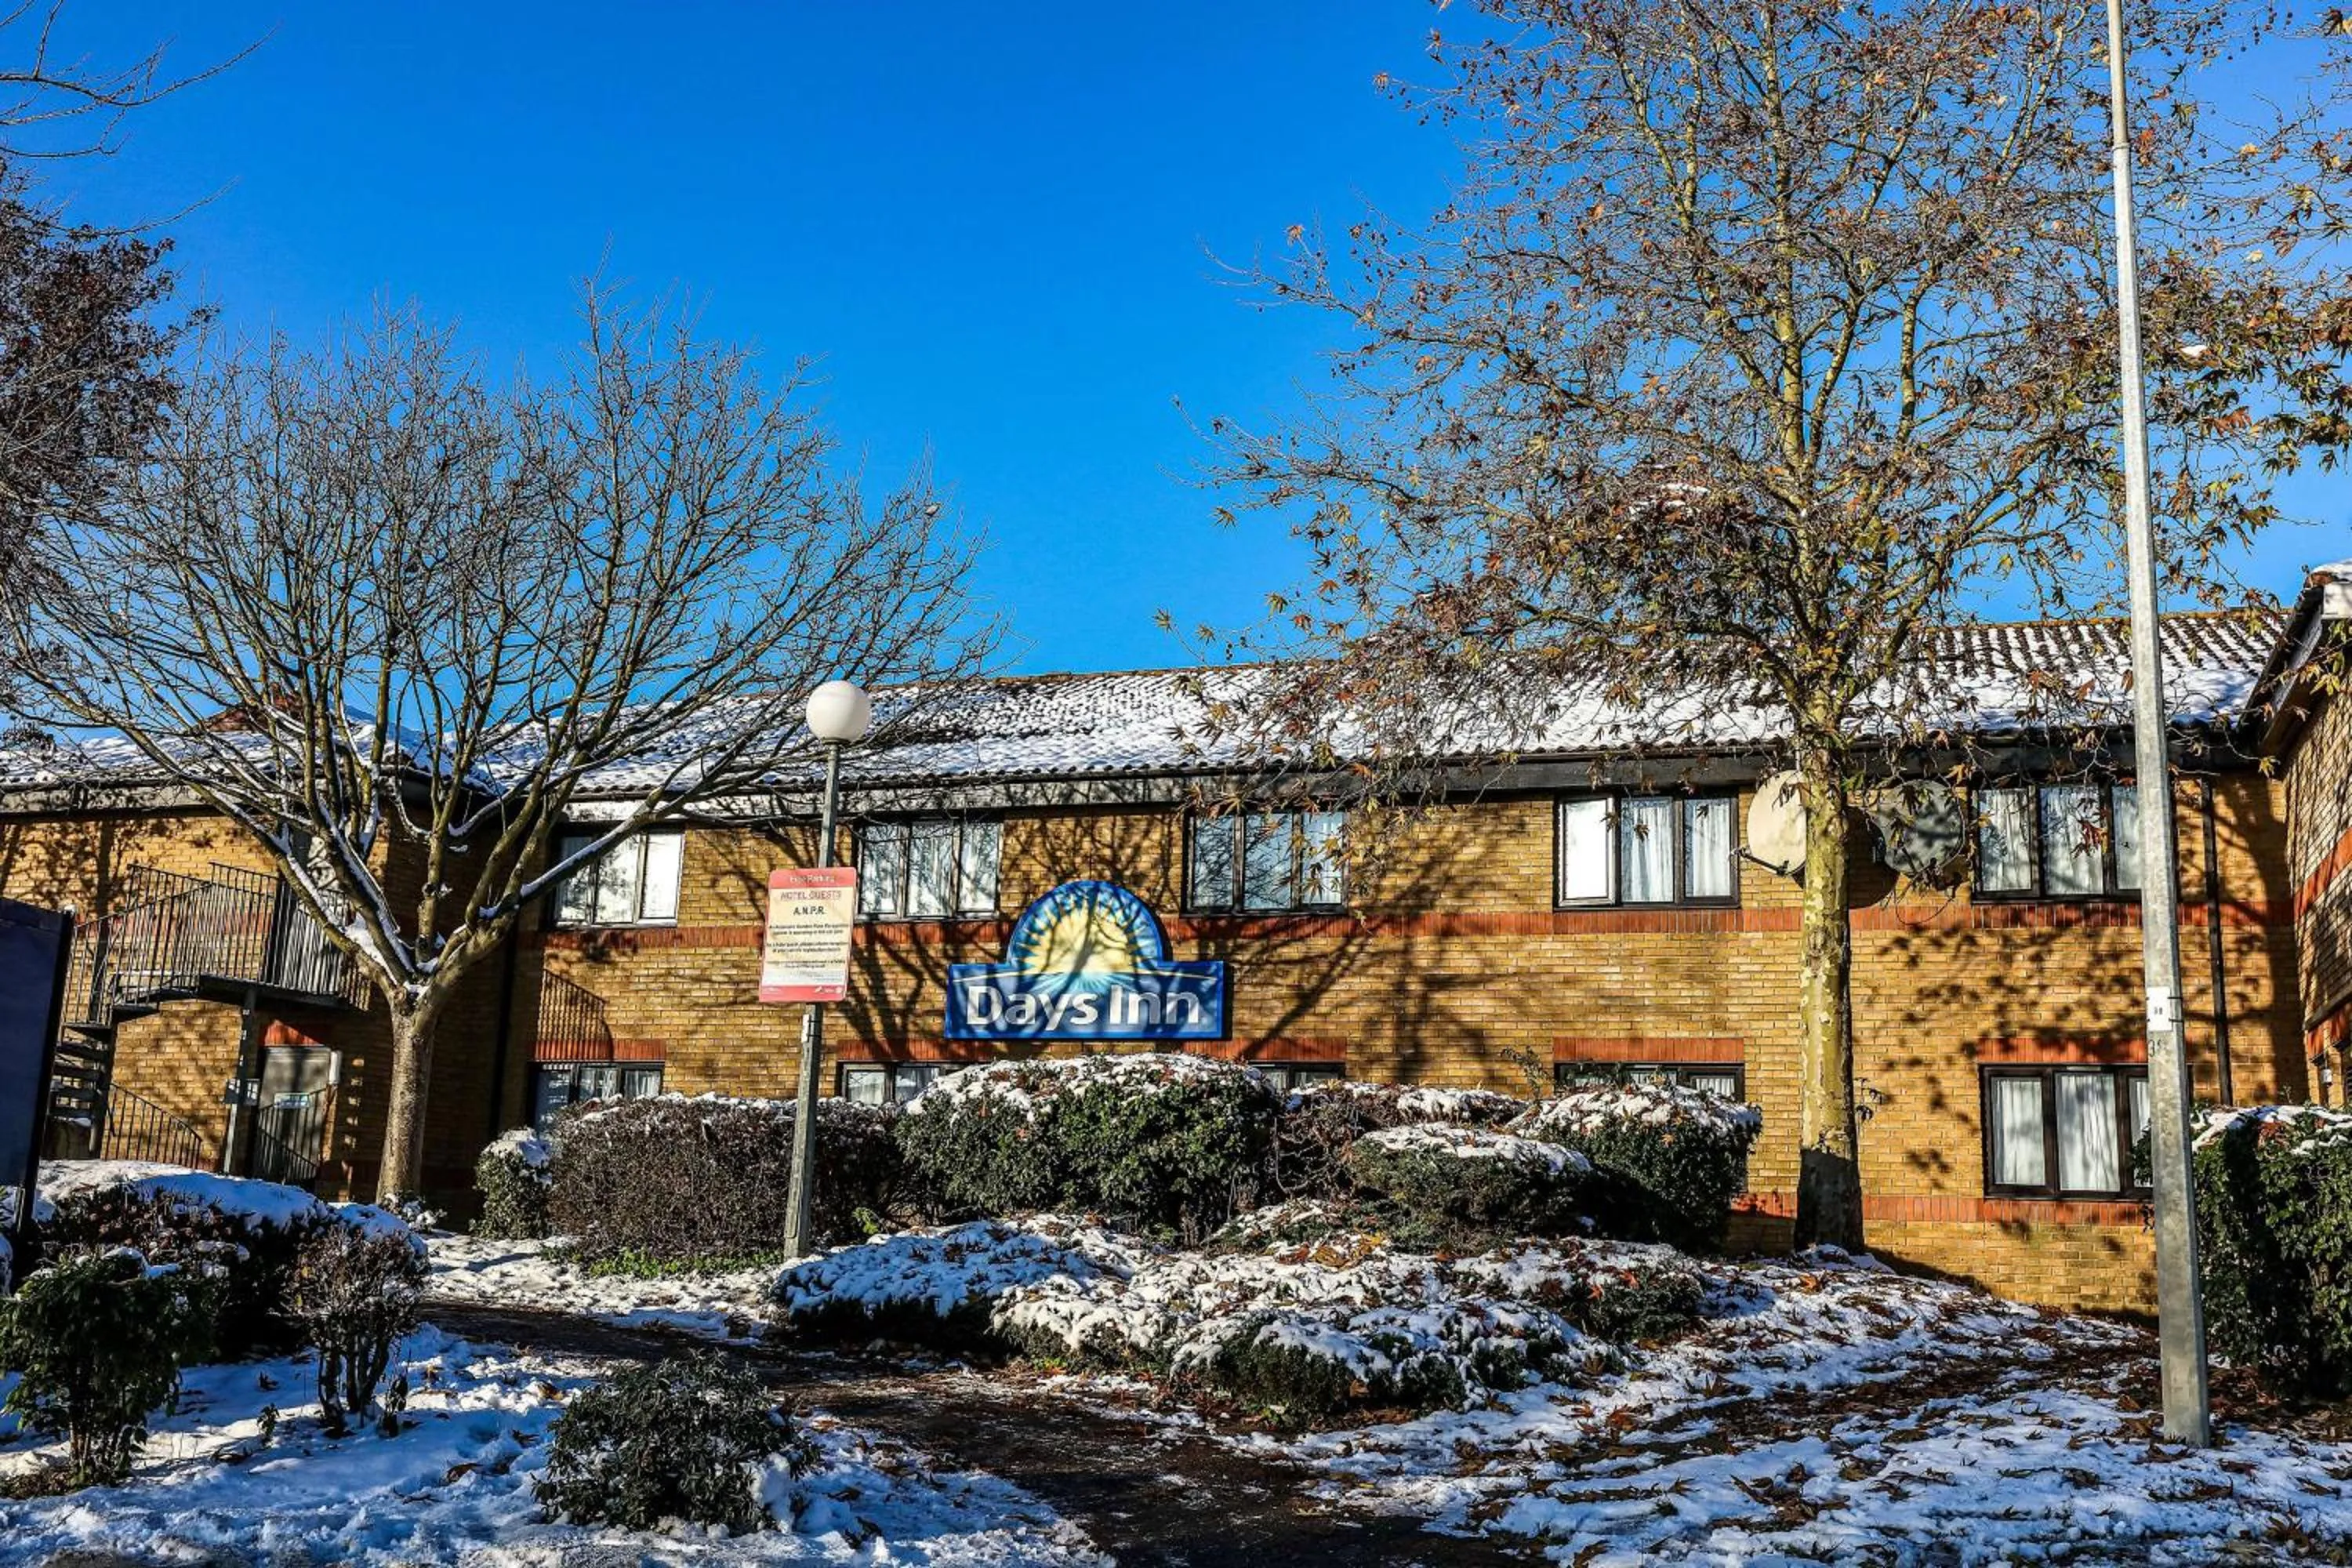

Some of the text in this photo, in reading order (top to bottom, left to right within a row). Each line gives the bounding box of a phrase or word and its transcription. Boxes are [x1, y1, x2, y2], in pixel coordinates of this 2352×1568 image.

[780, 891, 808, 900] HOTEL
[966, 984, 1200, 1030] Days Inn
